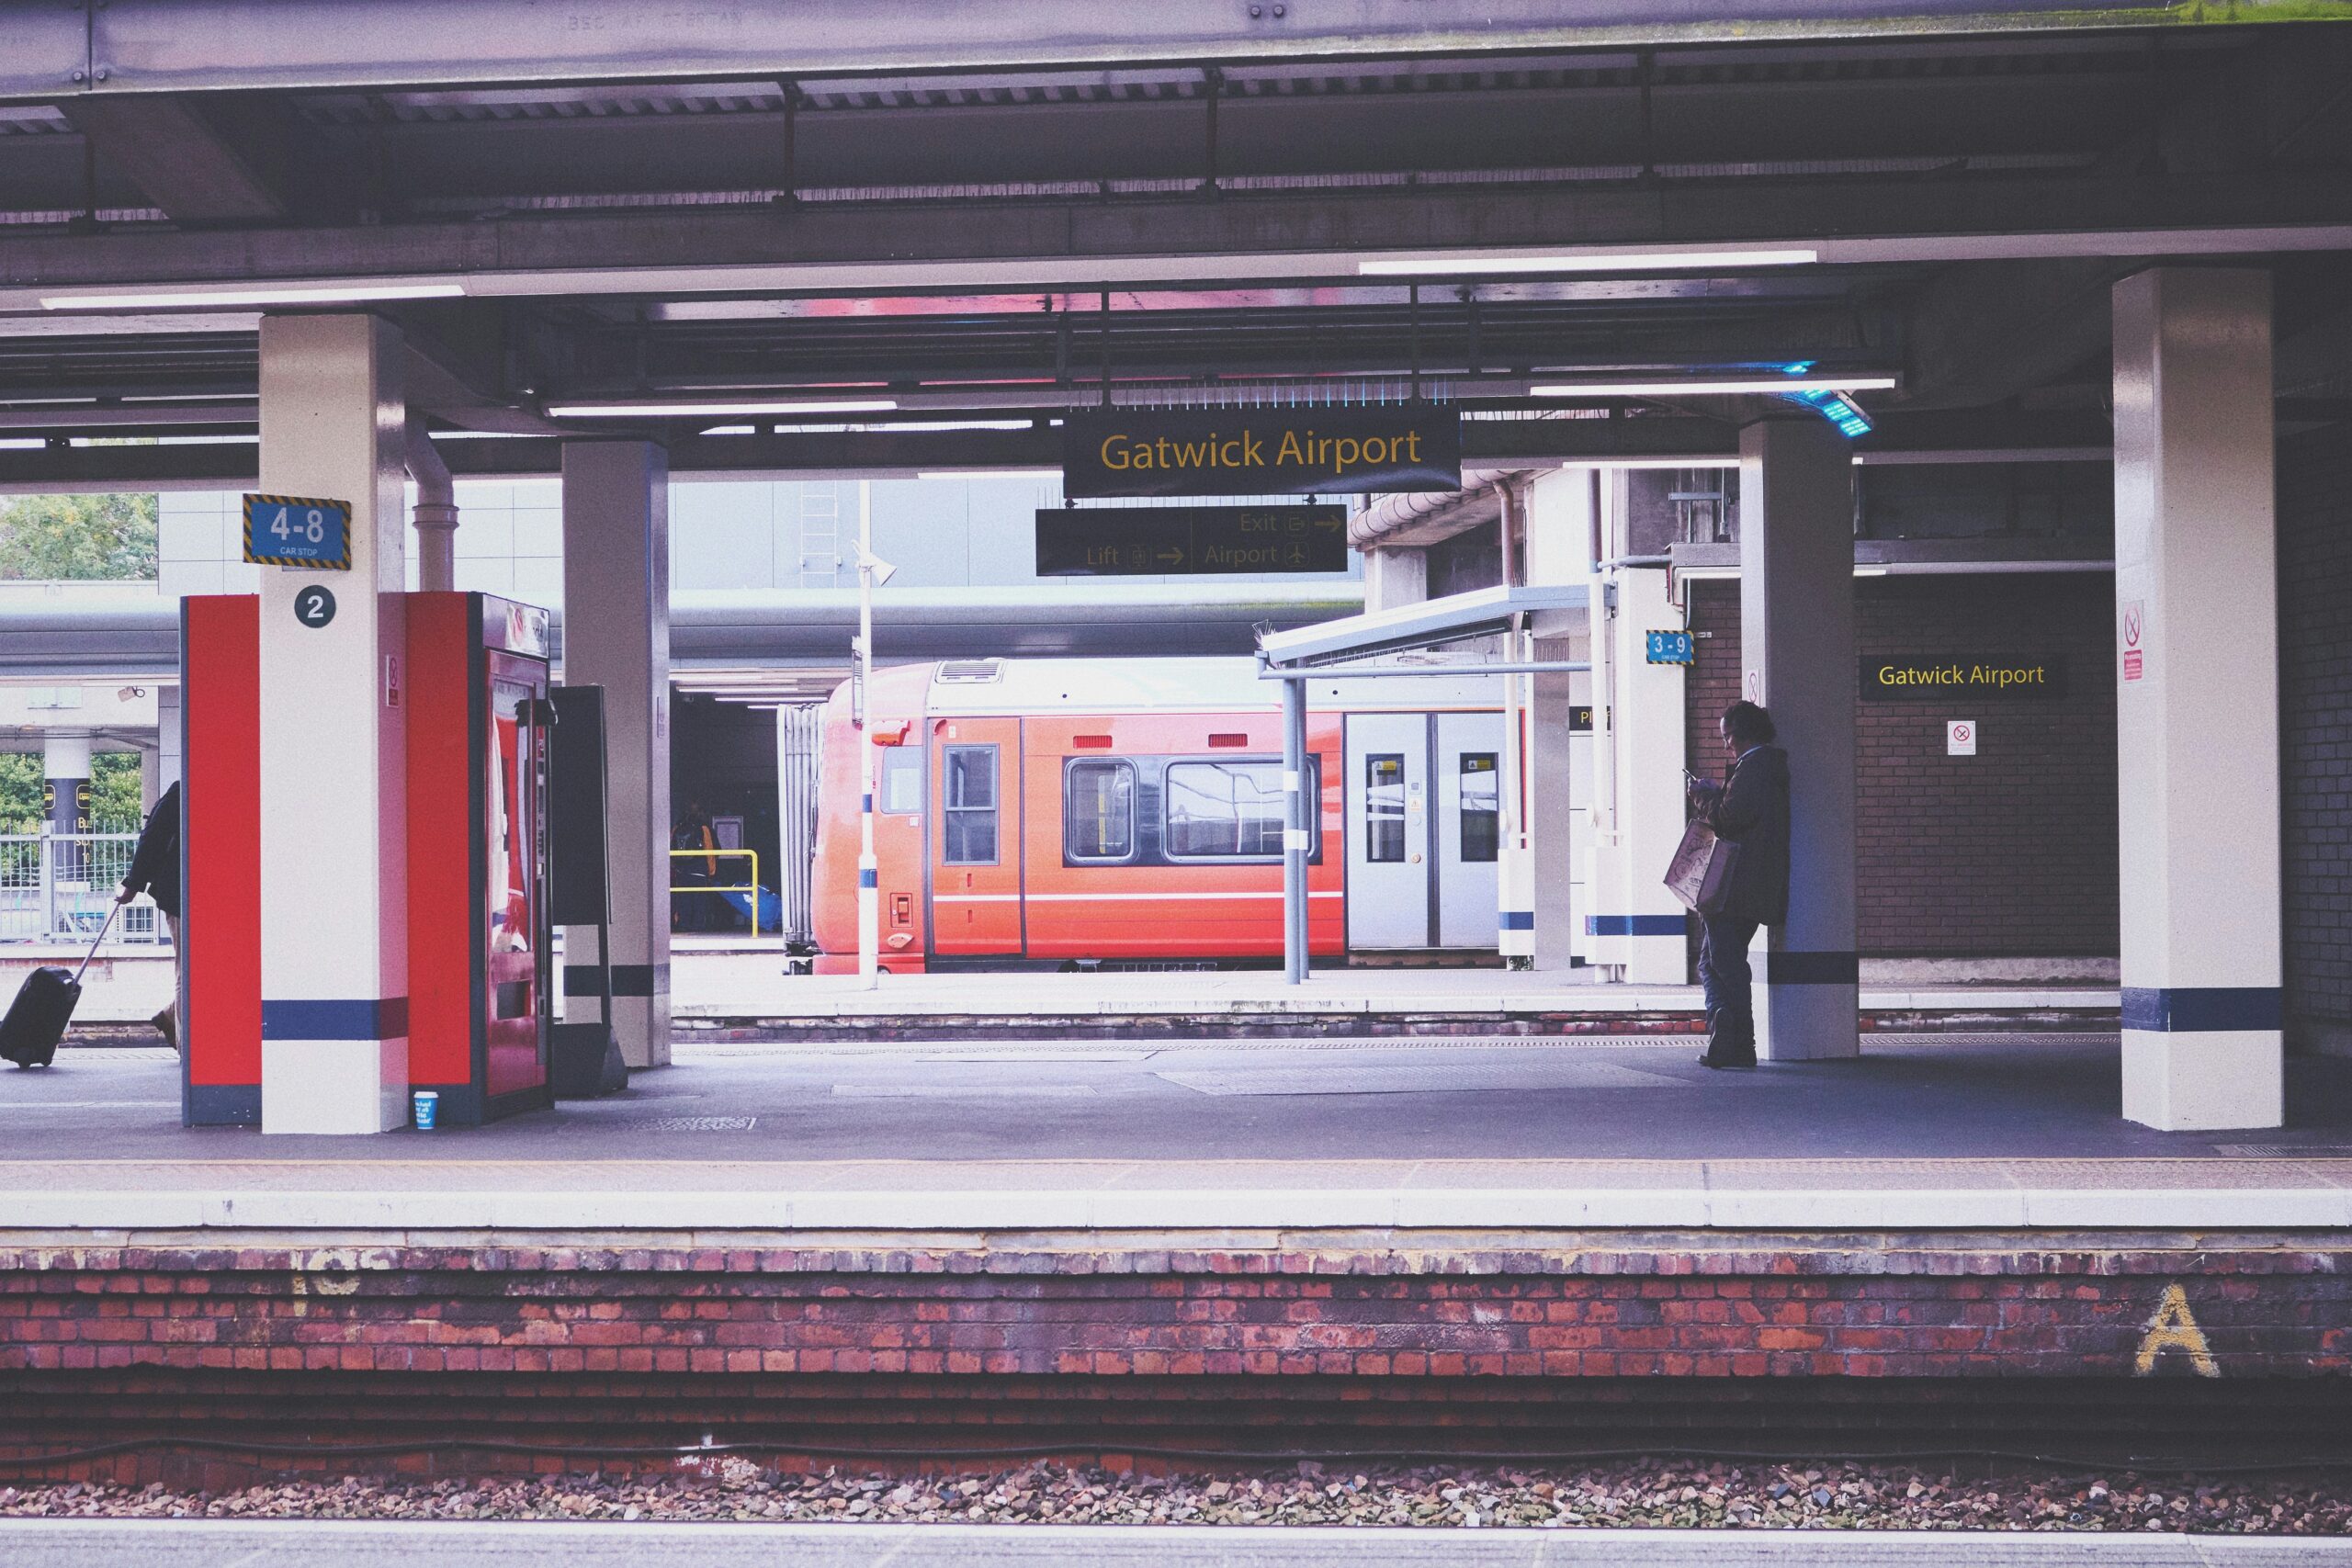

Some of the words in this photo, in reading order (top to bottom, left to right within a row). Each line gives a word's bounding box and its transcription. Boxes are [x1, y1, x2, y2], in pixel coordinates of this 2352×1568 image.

[1102, 430, 1265, 470] Gatwick
[1276, 429, 1422, 474] Airport
[270, 506, 324, 544] 4-8
[1239, 513, 1277, 533] Exit
[279, 547, 297, 556] CAR
[298, 547, 318, 557] STOP
[1087, 546, 1119, 566] Lift
[1204, 544, 1278, 568] Airport
[307, 594, 324, 618] 2
[1878, 664, 1964, 685] Gatwick
[1969, 665, 2044, 689] Airport
[2133, 1282, 2222, 1379] A
